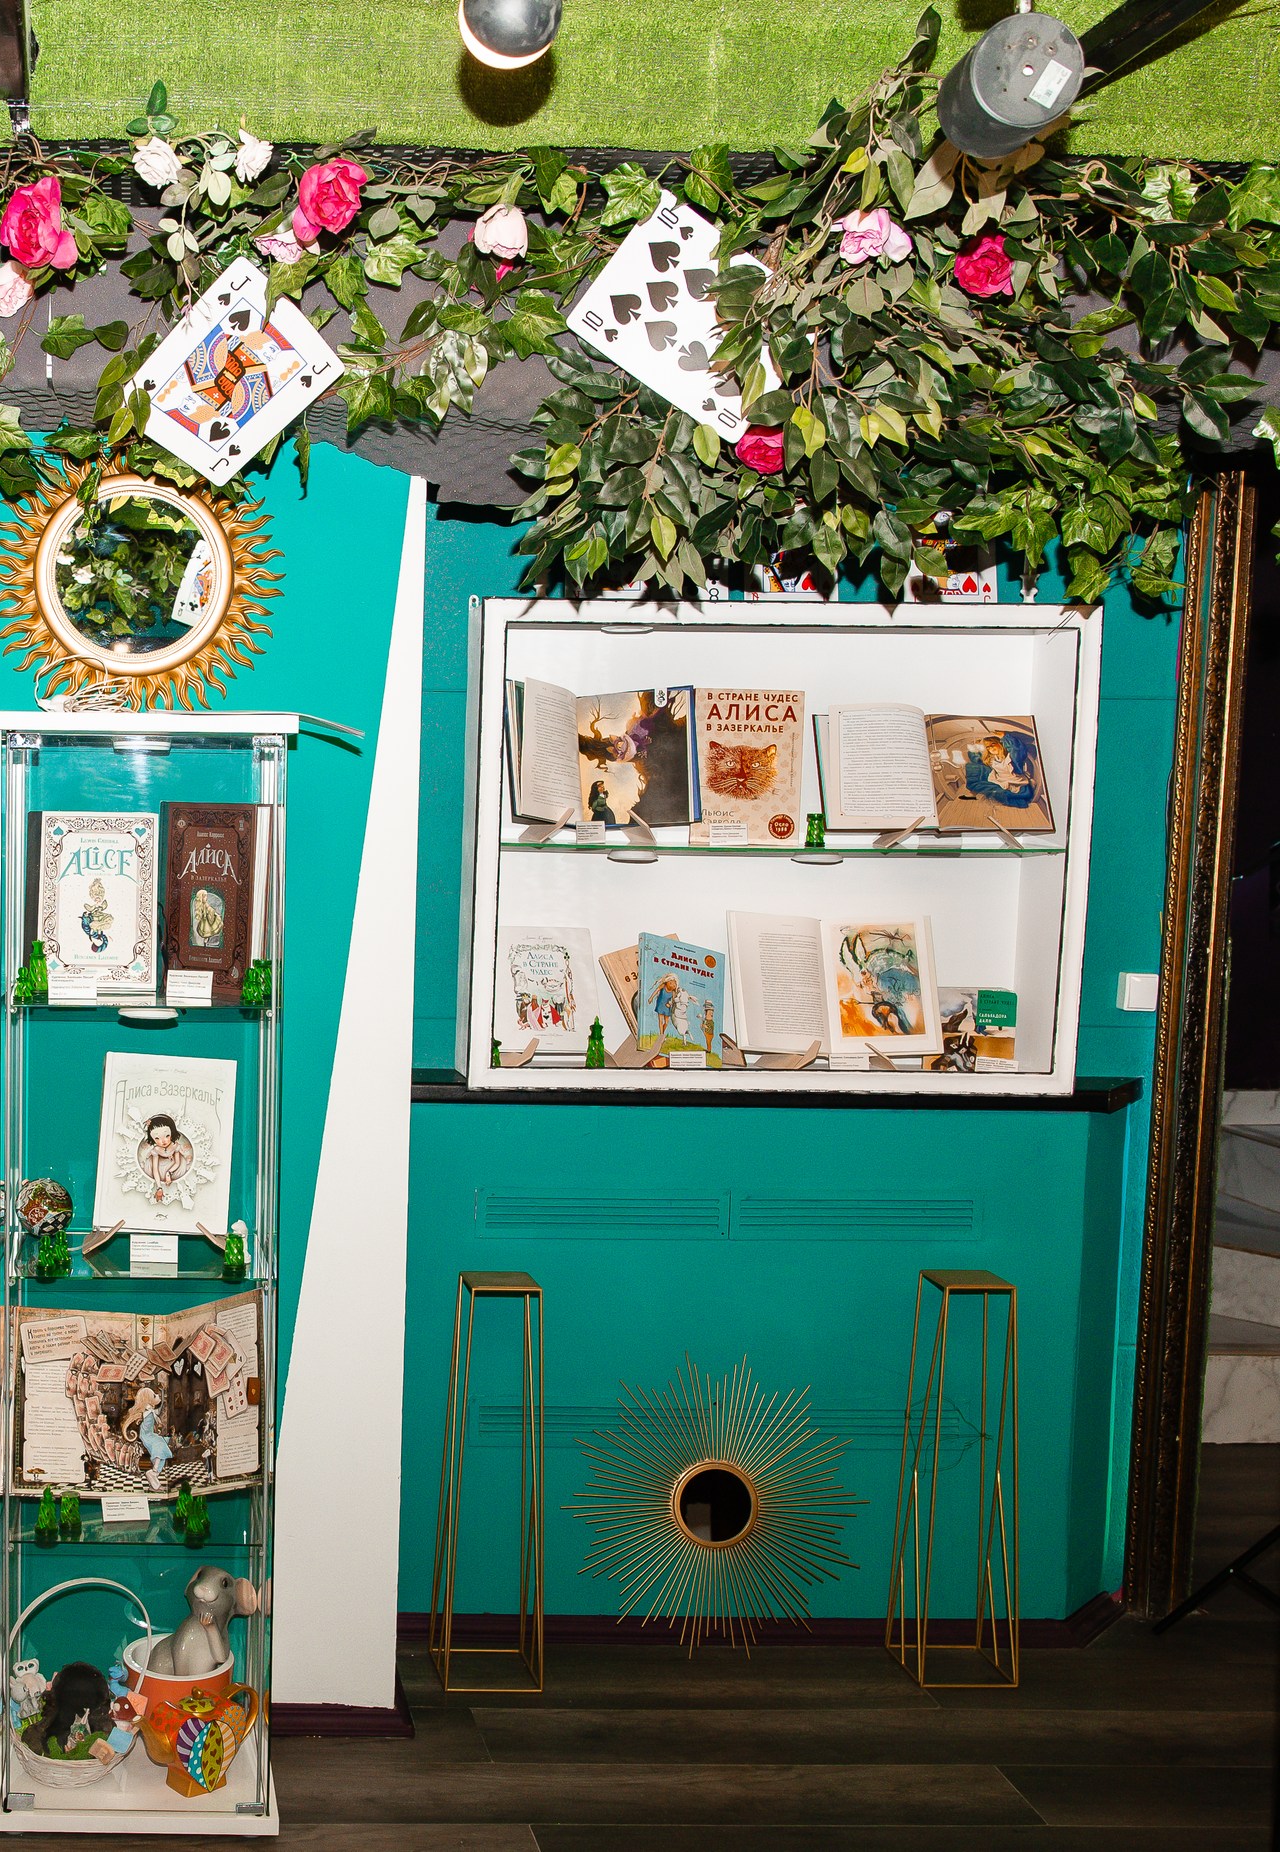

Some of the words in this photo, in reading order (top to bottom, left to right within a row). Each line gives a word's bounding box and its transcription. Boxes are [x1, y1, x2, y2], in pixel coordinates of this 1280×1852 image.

[657, 207, 679, 230] 10
[231, 276, 251, 291] J
[582, 310, 603, 332] 10
[312, 362, 331, 375] J
[718, 408, 742, 429] 10
[209, 457, 229, 472] J
[718, 693, 759, 701] СТРАНЕ
[764, 694, 798, 703] ЧУДЕС
[707, 703, 797, 722] АЛИСА
[717, 724, 784, 733] ЗАЗЕРКАЛЬЕ
[57, 846, 140, 886] ALICE
